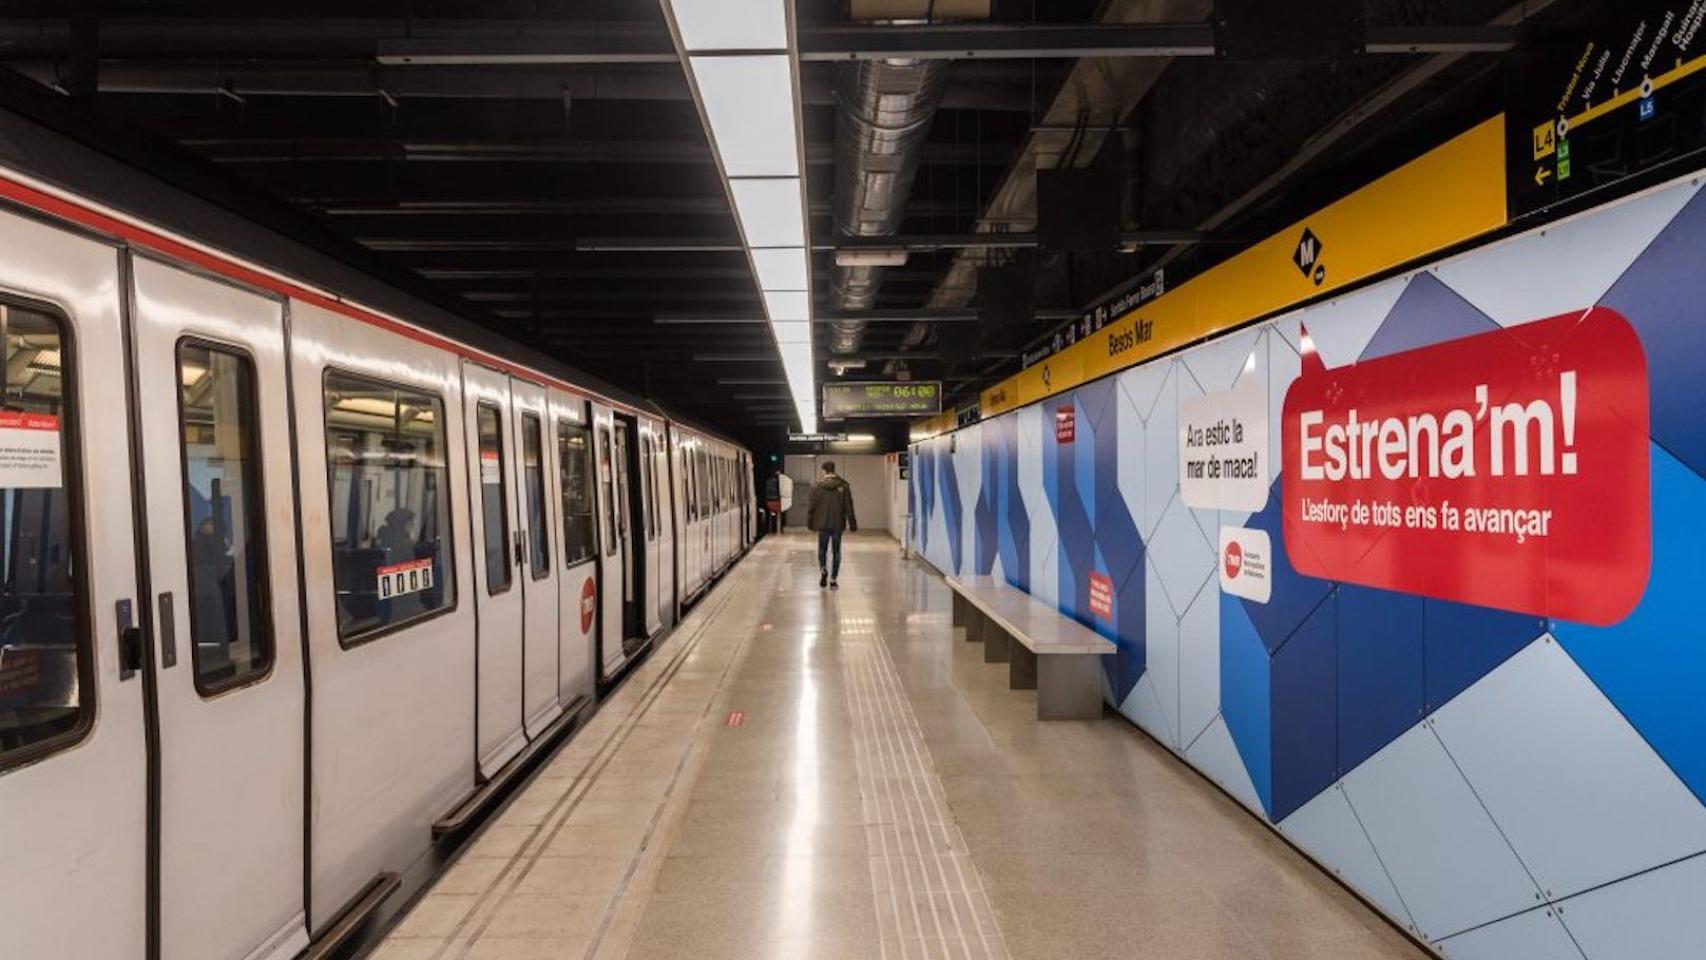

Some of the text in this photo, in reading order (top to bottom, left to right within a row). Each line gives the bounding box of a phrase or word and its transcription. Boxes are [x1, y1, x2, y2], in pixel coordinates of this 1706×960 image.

[1641, 10, 1674, 70] Maragall
[1581, 80, 1596, 99] Via
[1536, 130, 1552, 152] L4
[1301, 238, 1314, 267] M
[1109, 319, 1153, 357] Besòs Mar
[1187, 418, 1243, 447] Ara estic la
[1300, 370, 1578, 481] Estrena'm!
[1187, 451, 1258, 479] mar de maca!
[1301, 498, 1552, 544] L'esforç de tots ens fa avançar
